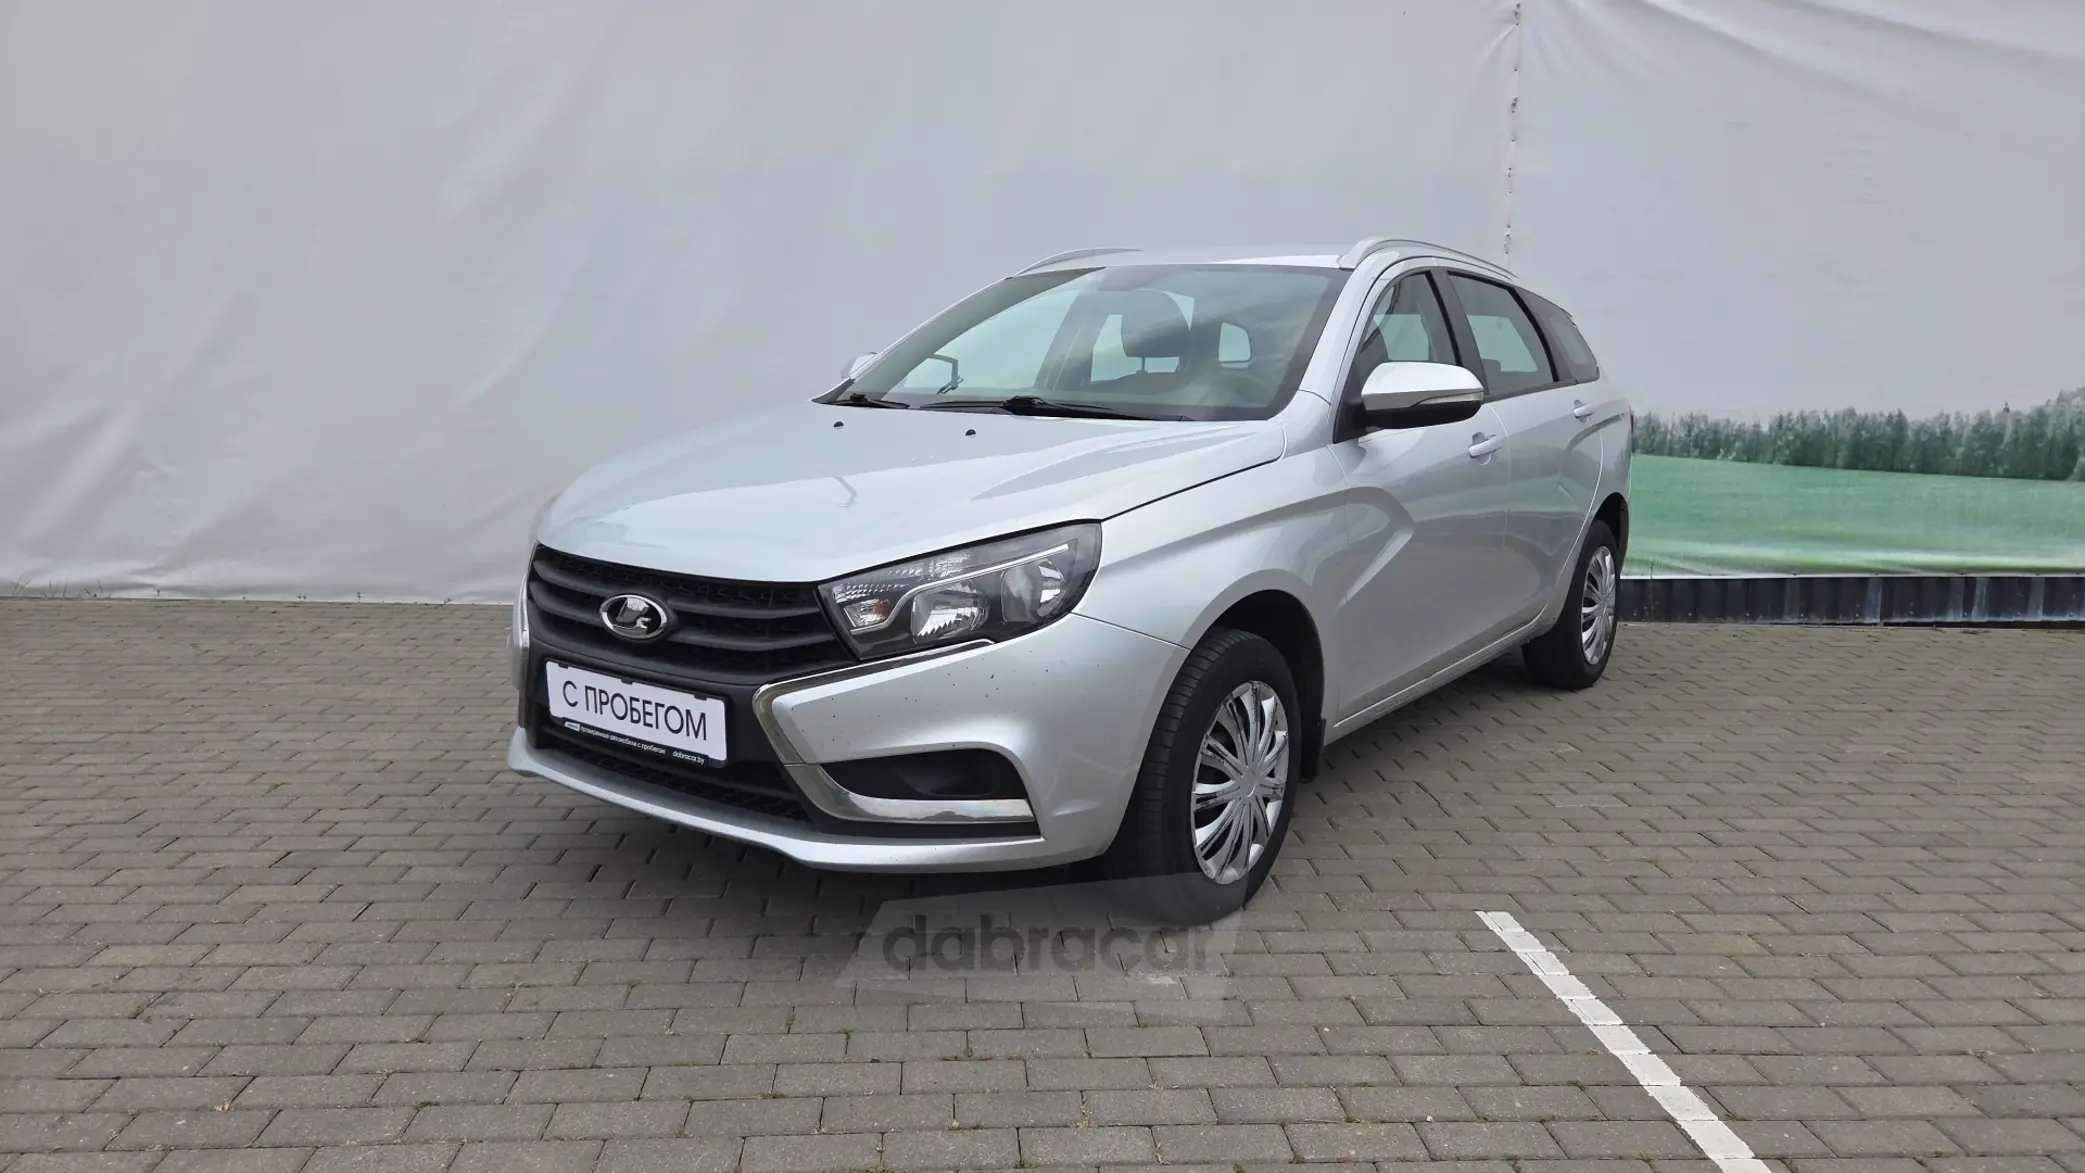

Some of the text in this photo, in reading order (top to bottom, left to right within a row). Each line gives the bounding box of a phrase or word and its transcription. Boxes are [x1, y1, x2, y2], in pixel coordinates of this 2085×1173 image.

[563, 681, 707, 740] С ПРОБЕГОМ
[642, 744, 666, 754] пробегом
